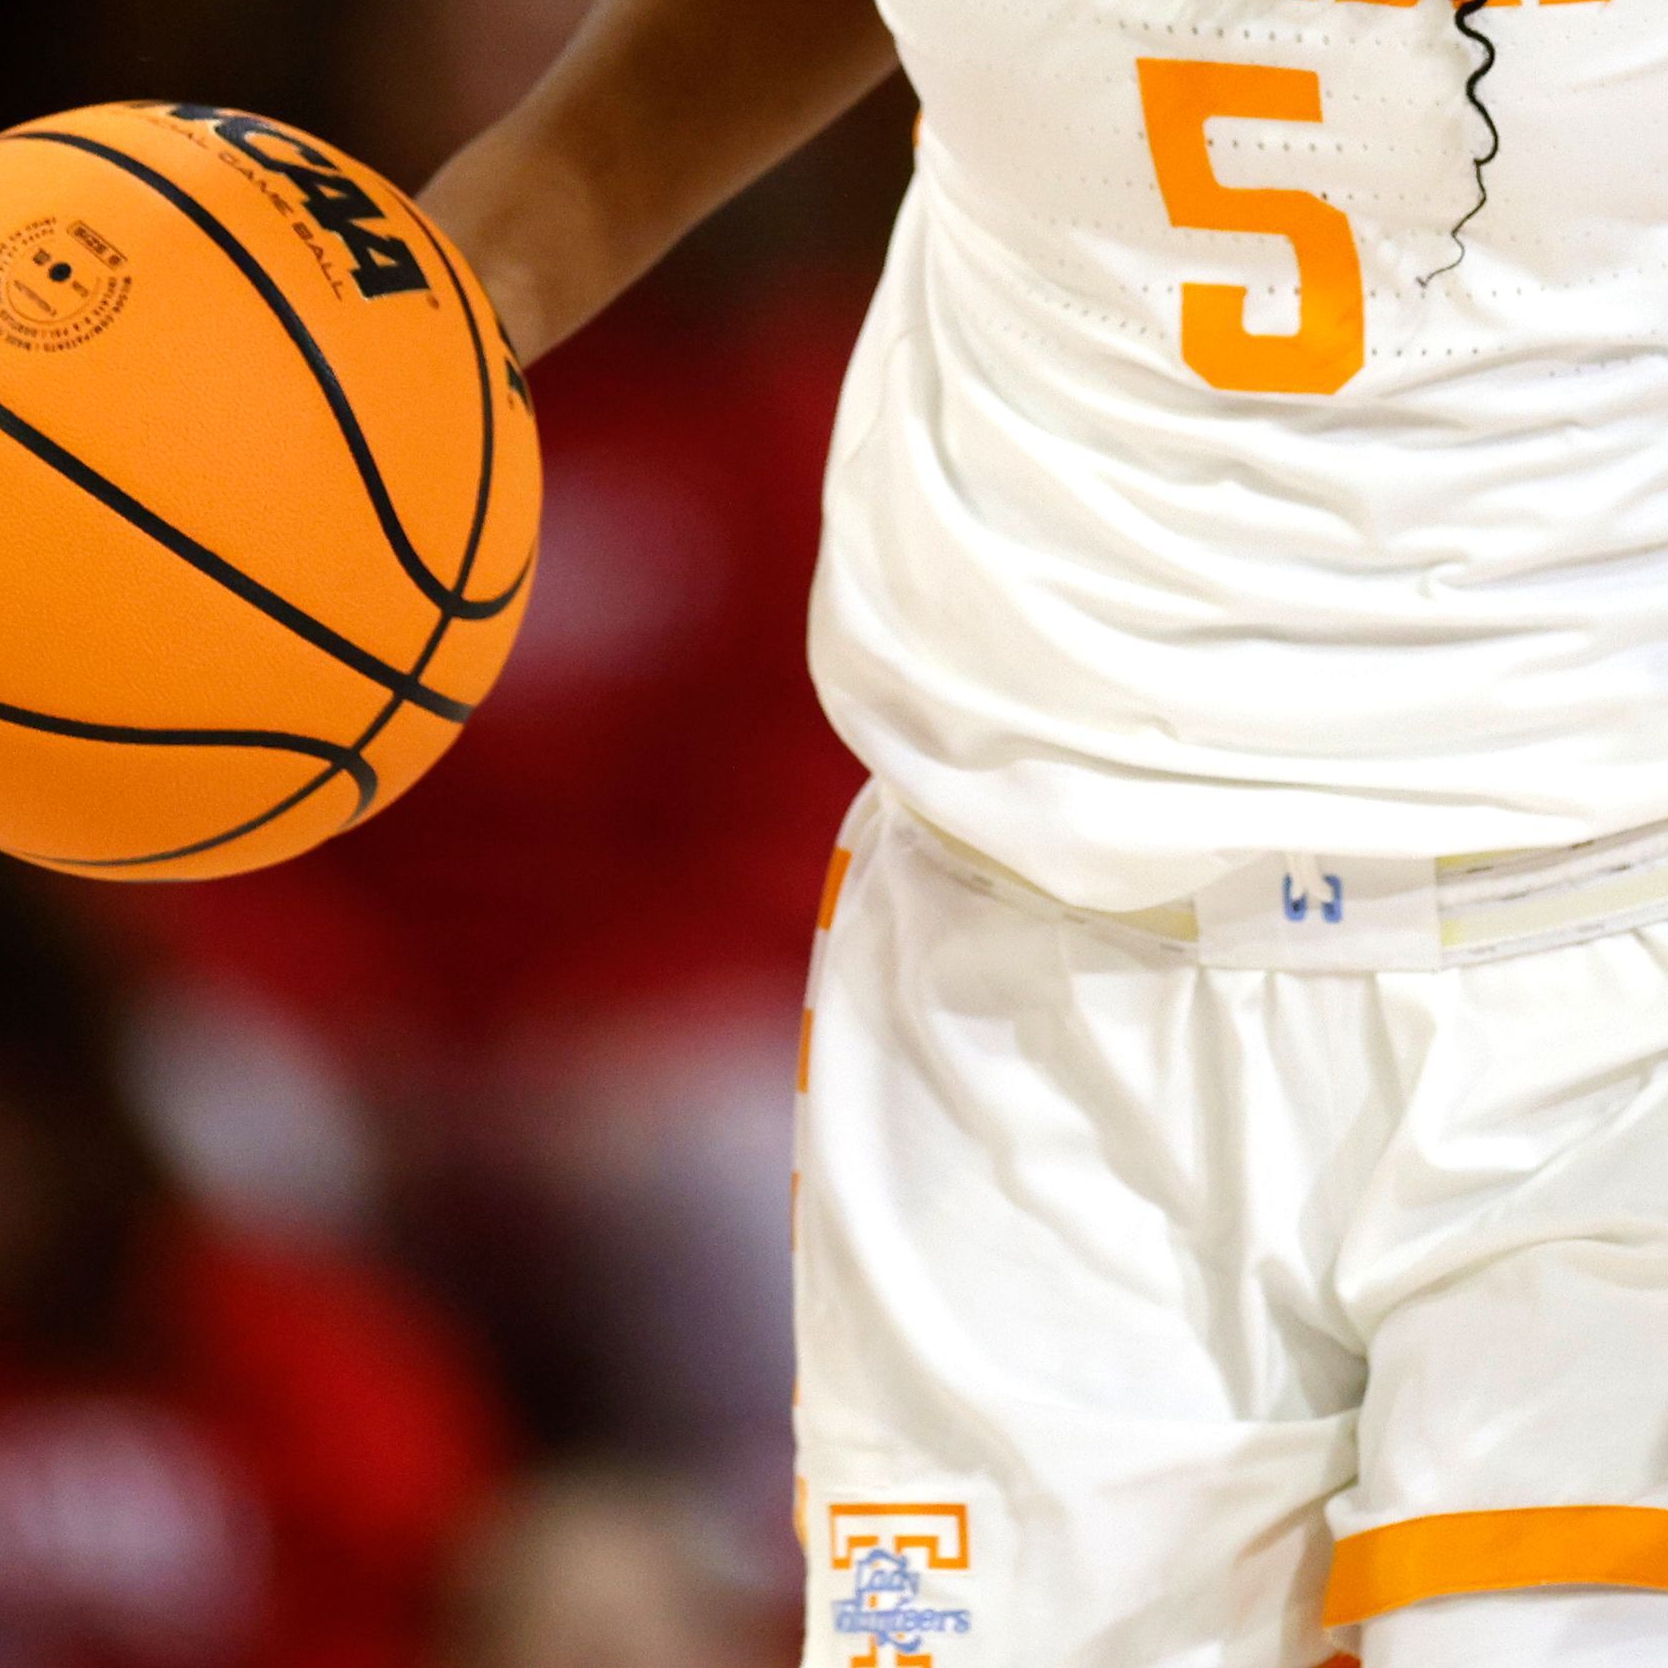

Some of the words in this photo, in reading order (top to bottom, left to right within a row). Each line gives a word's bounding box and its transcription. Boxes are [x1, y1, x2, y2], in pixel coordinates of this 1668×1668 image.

[217, 150, 295, 219] GAME
[291, 221, 343, 302] BALL
[1135, 57, 1365, 395] 5
